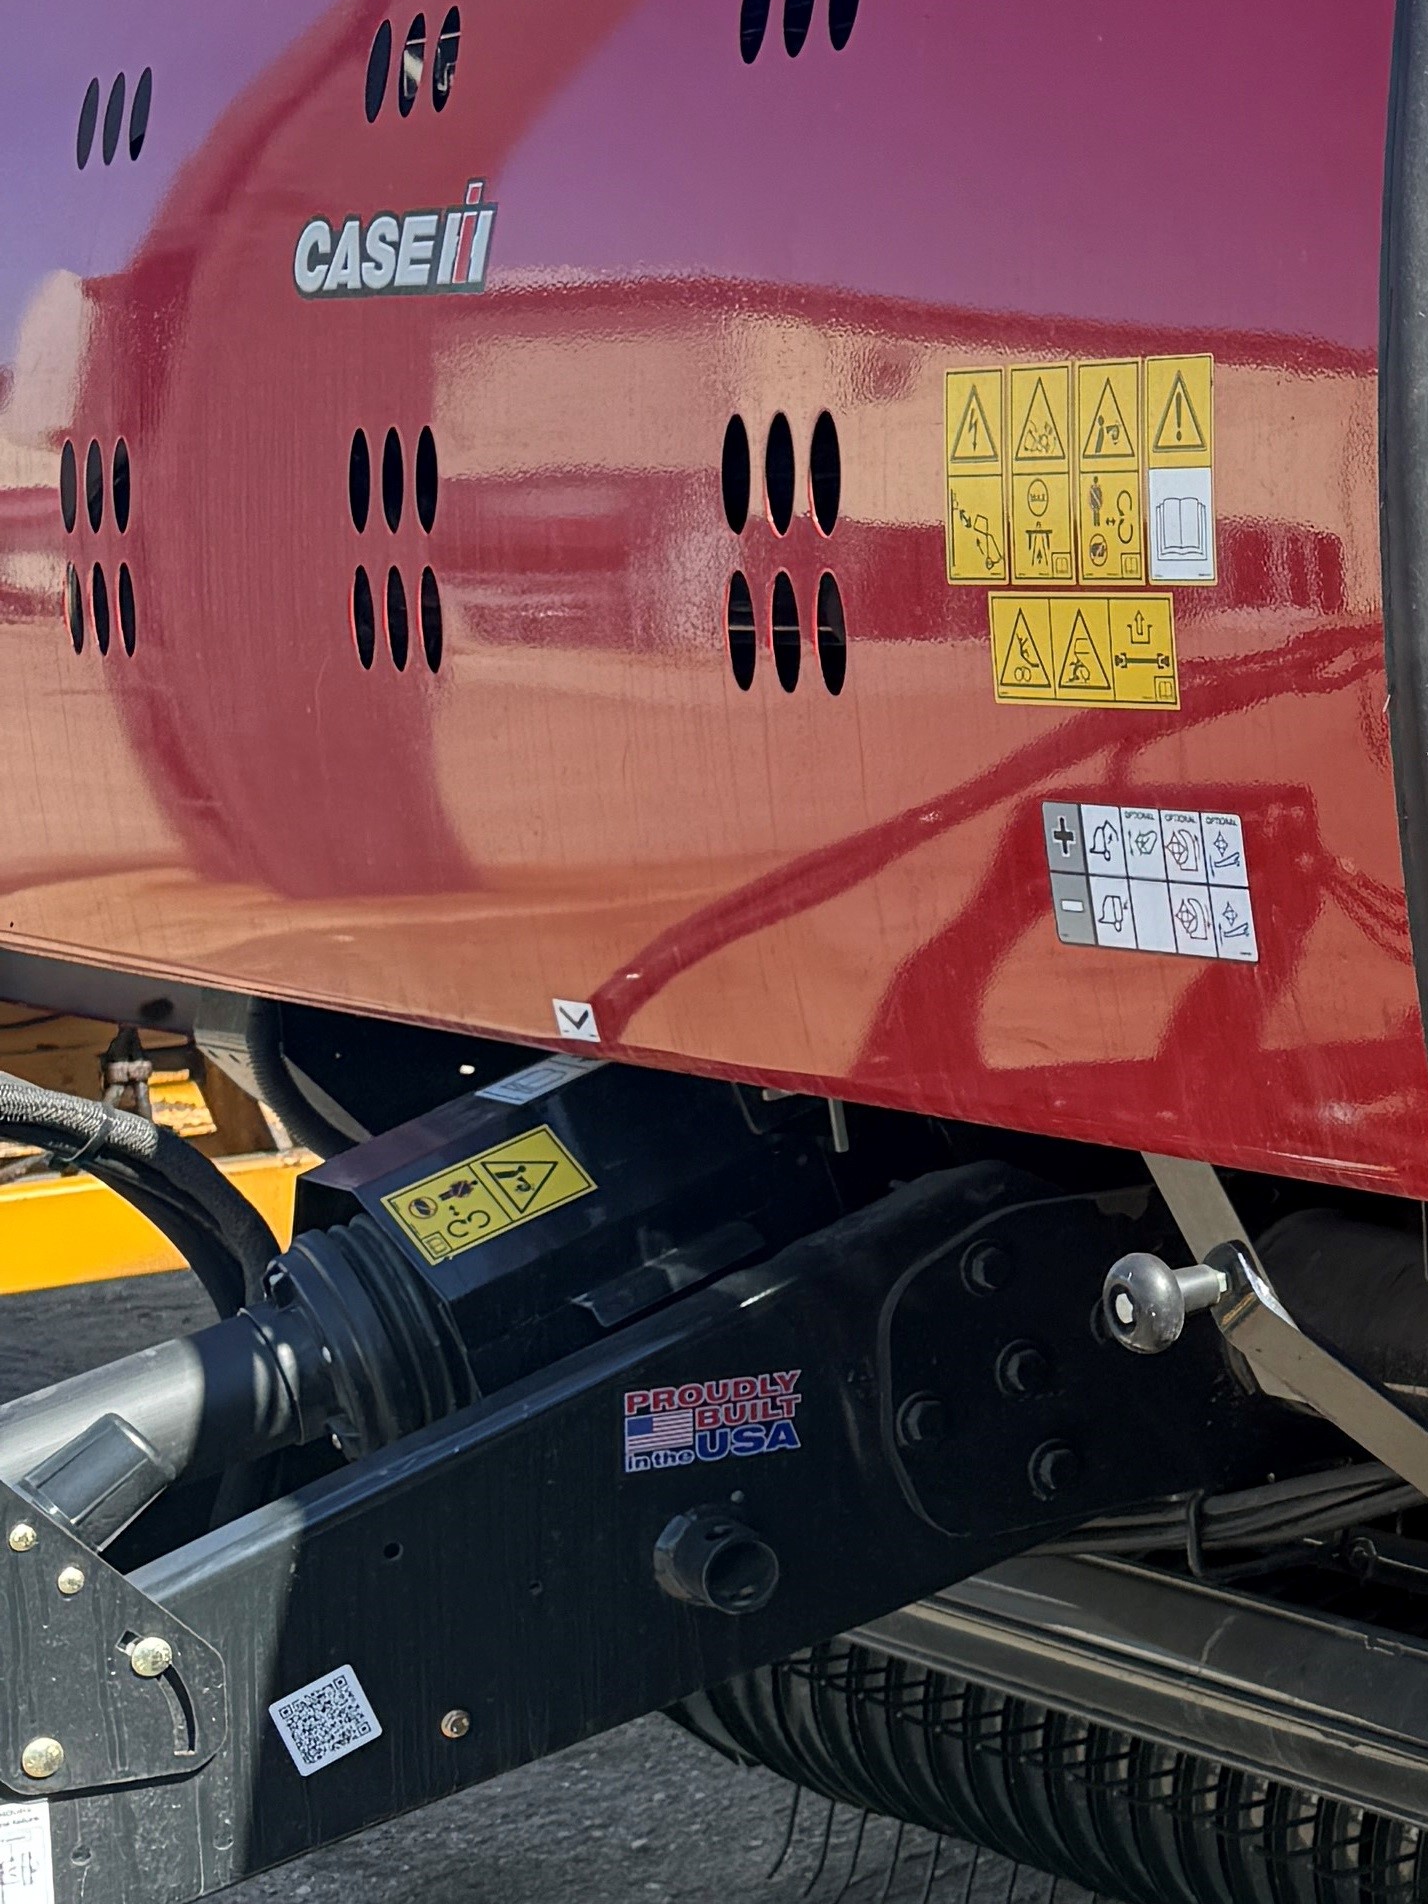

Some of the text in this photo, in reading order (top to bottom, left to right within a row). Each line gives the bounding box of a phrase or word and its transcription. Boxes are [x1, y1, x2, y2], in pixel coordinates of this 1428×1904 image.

[294, 214, 439, 294] CASE
[625, 1370, 801, 1416] PROUDLY
[695, 1394, 801, 1431] BUILT
[625, 1420, 801, 1473] in the USA
